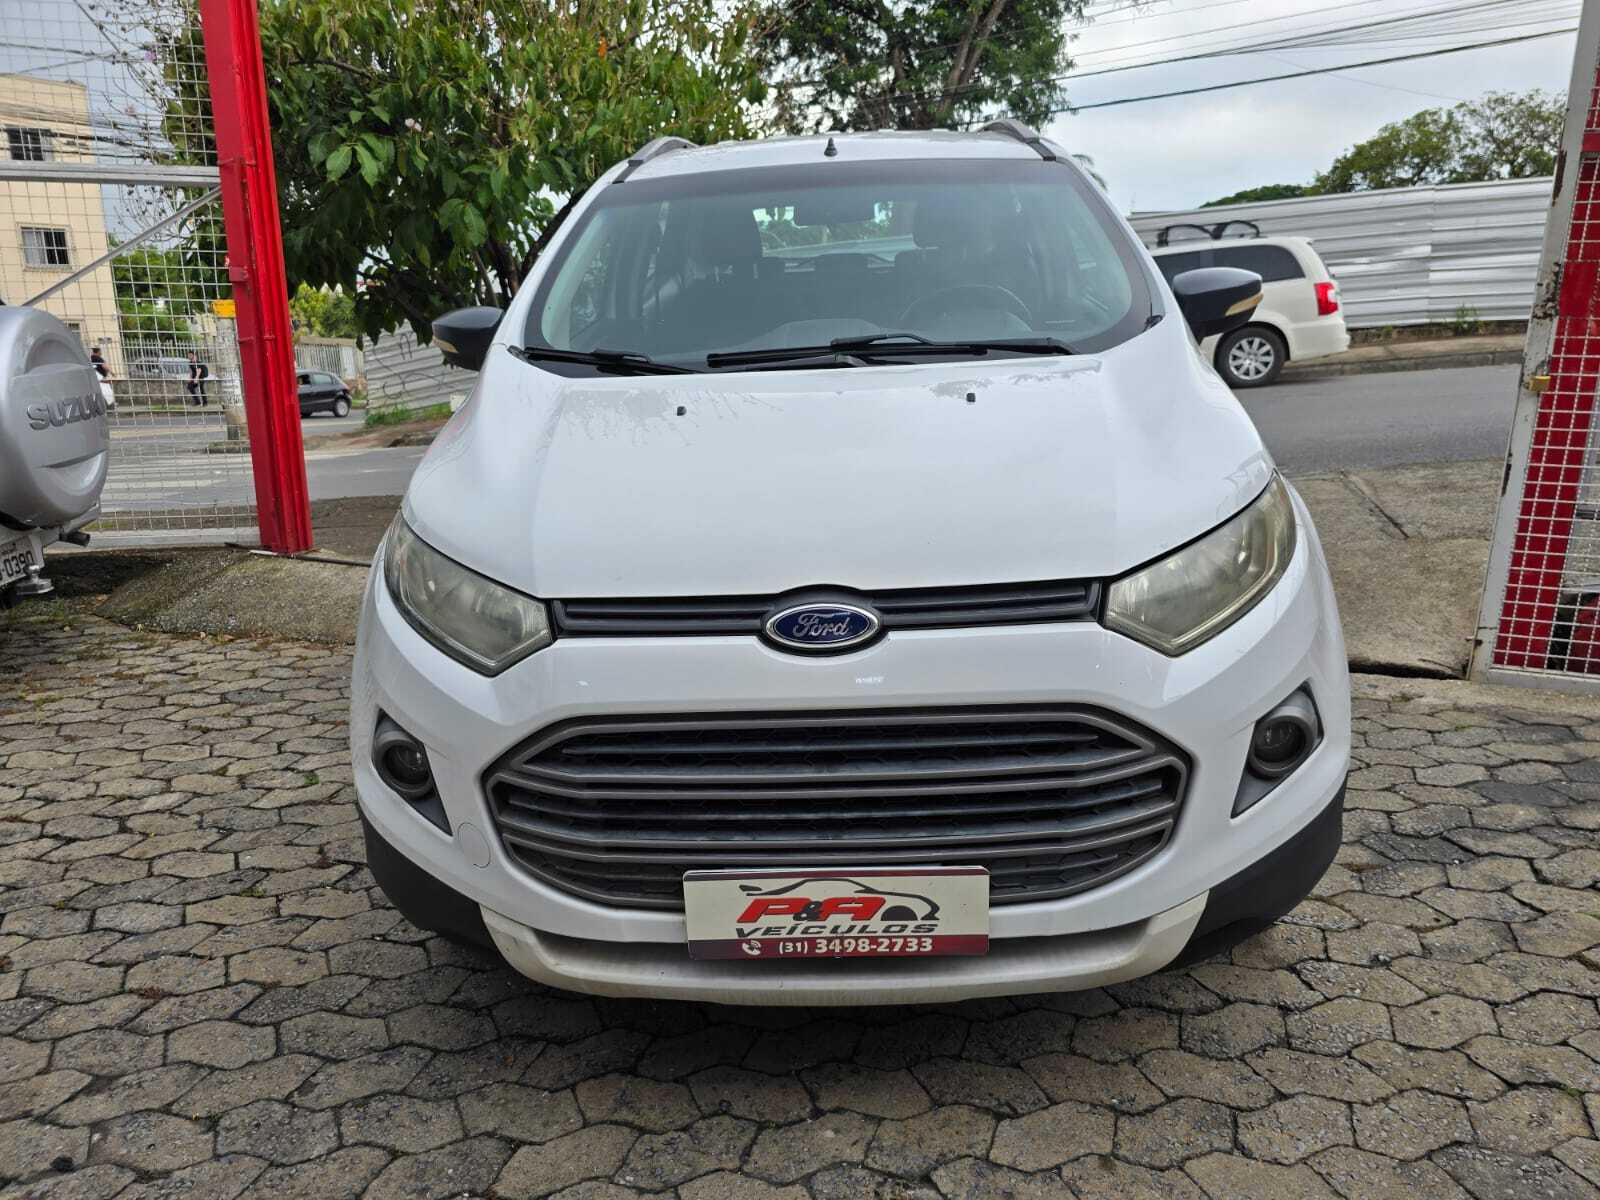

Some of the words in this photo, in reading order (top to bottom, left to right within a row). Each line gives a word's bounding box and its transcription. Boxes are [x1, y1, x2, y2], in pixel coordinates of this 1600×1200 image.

[792, 611, 851, 636] Ford
[736, 897, 886, 924] P&A
[736, 922, 938, 938] VEÍCULOS
[779, 940, 808, 955] (31)
[815, 937, 933, 954] 3498-2733
